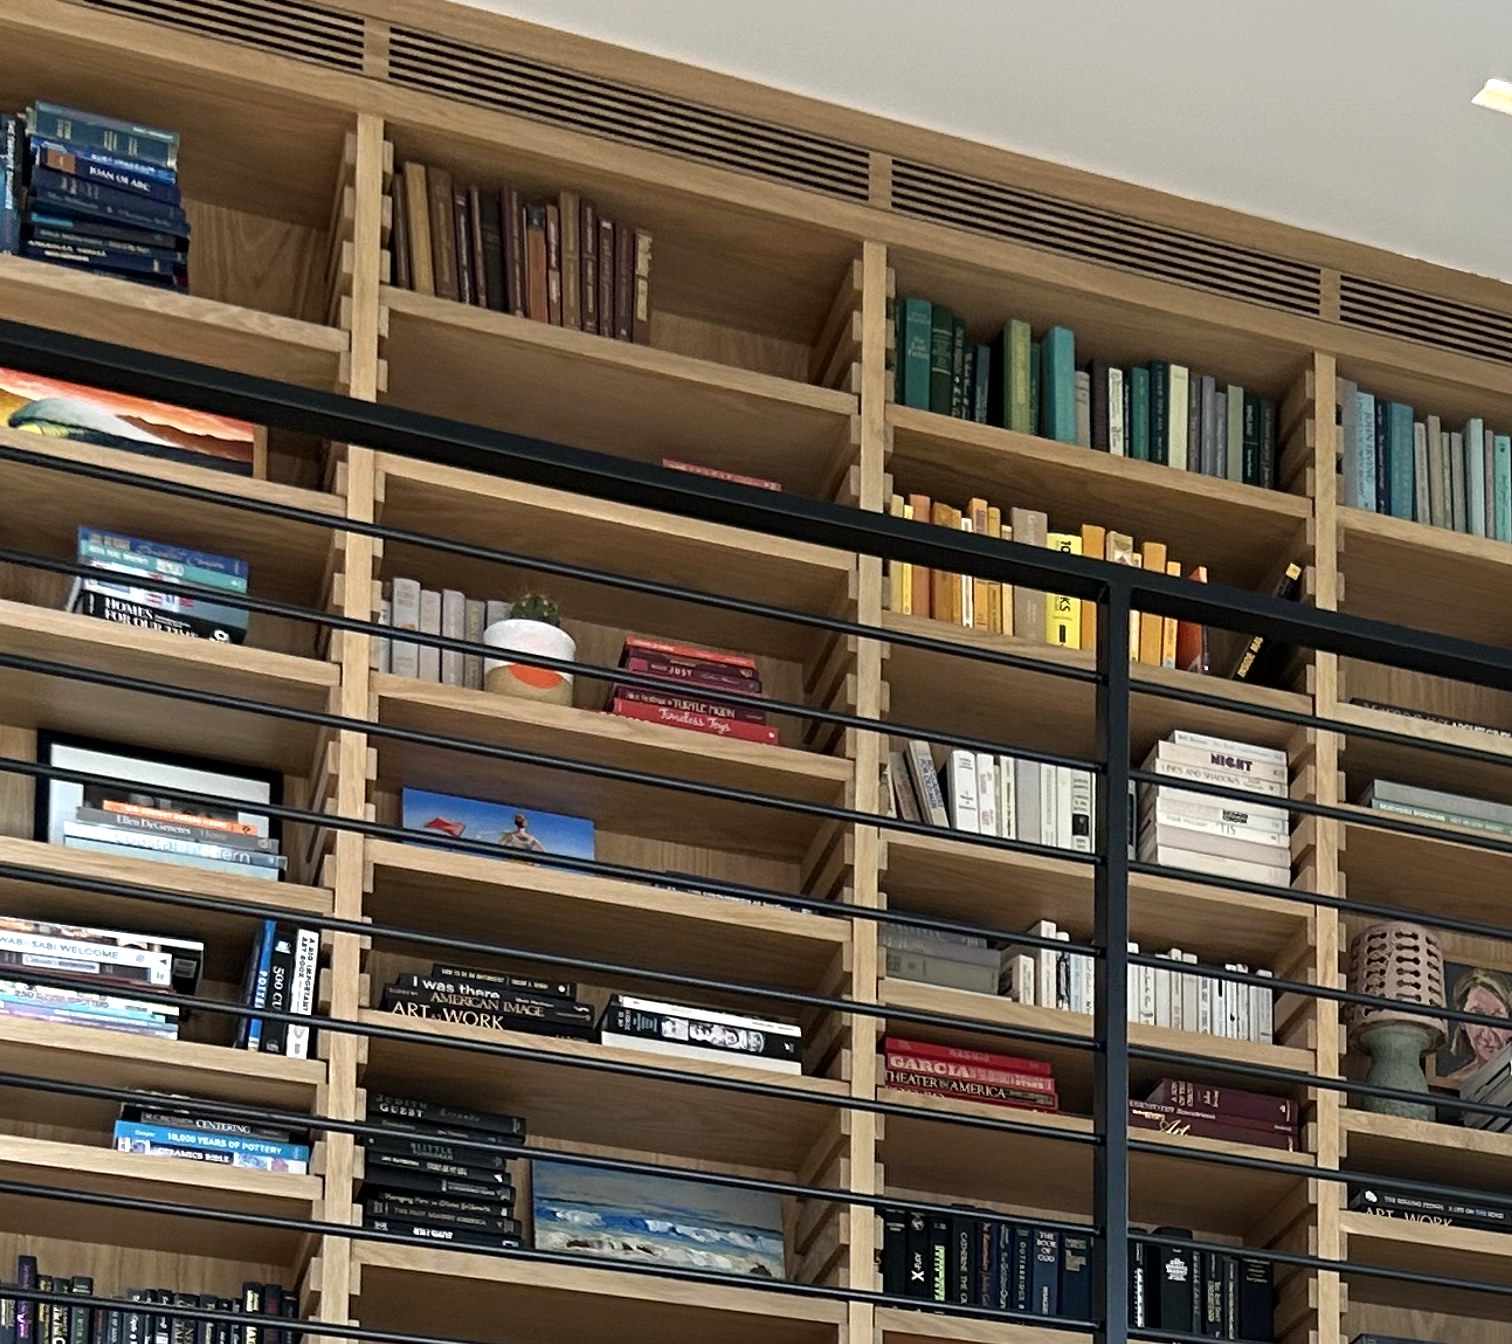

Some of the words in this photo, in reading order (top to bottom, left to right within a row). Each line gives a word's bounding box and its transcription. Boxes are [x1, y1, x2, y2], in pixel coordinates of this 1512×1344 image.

[104, 597, 155, 620] HOMES
[1209, 753, 1254, 772] NIGHT
[273, 966, 286, 991] 500
[422, 979, 454, 993] was
[459, 985, 501, 1000] there
[430, 990, 500, 1013] AMERICAN
[503, 1001, 546, 1018] IMAGE
[392, 1001, 430, 1019] ART
[441, 1006, 504, 1031] WORK
[889, 1056, 971, 1078] GARCIA
[950, 1079, 1008, 1099] AMERICA
[198, 1136, 227, 1148] YEARS
[228, 1141, 241, 1149] OF
[242, 1142, 282, 1155] POTTERY
